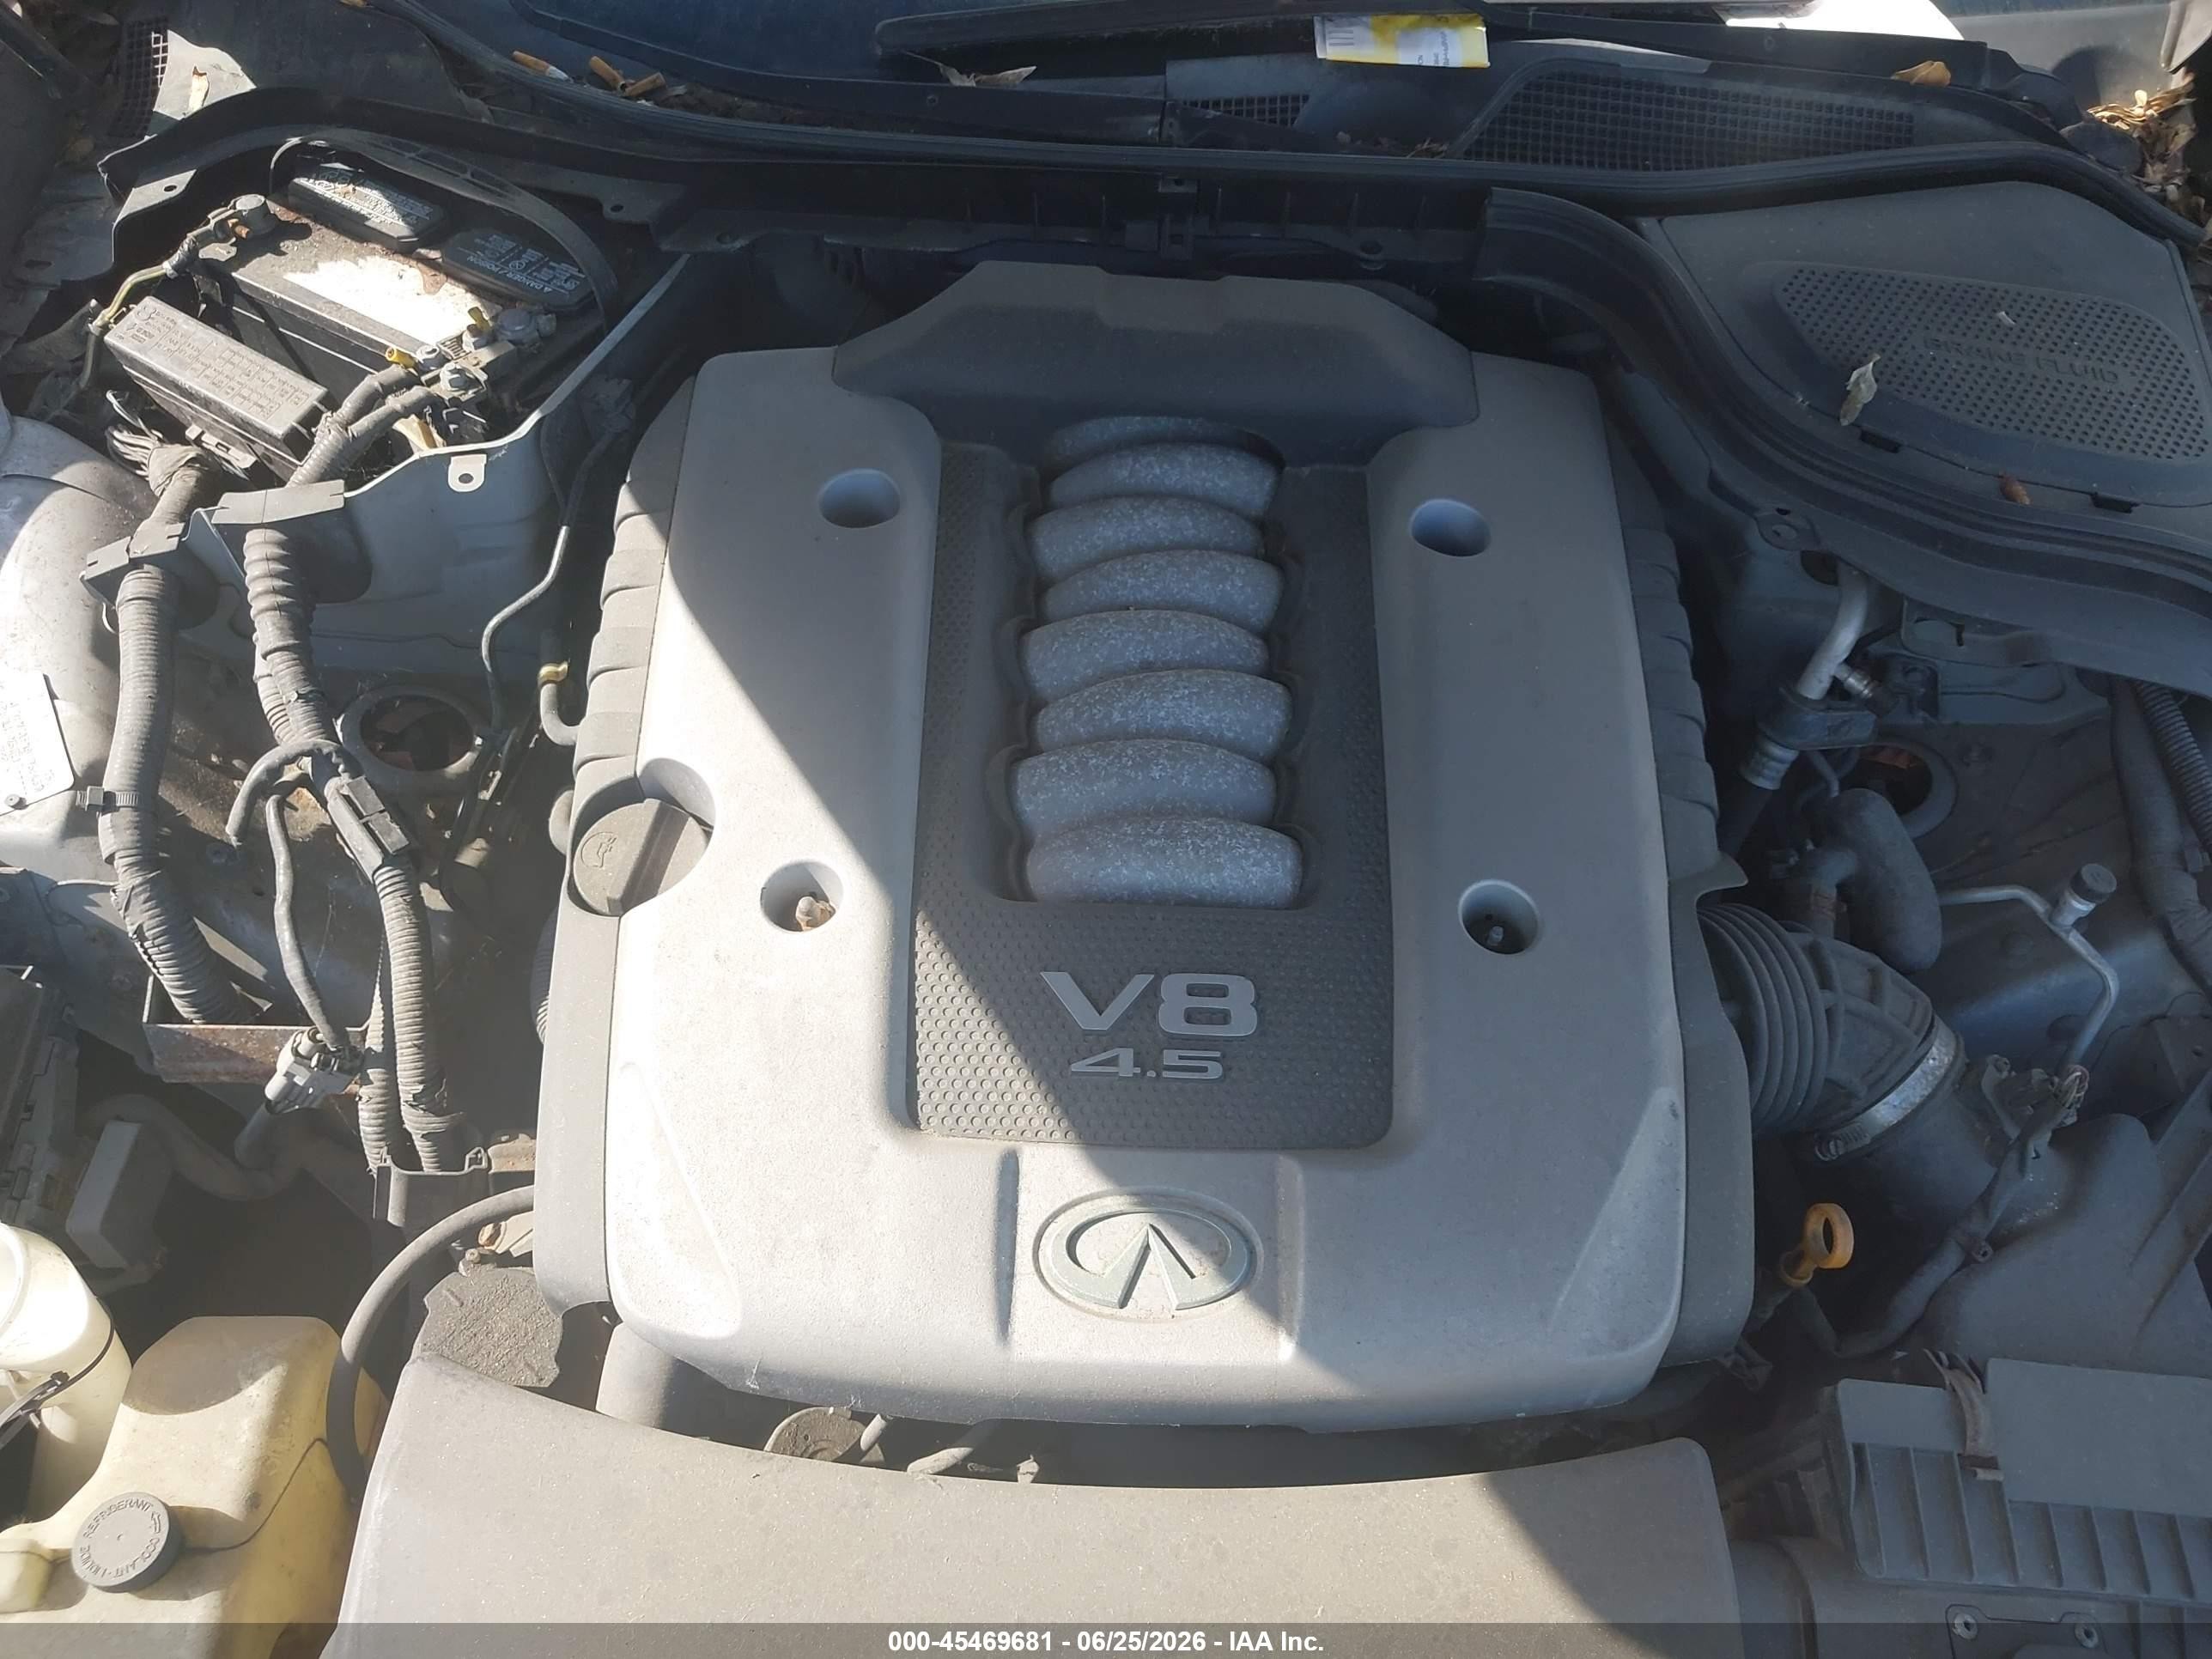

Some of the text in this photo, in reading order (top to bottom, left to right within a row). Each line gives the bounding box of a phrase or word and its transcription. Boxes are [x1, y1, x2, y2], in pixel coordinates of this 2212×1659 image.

[2035, 355, 2120, 386] FLUID
[1039, 970, 1259, 1037] V8
[1070, 1047, 1224, 1080] 4.5
